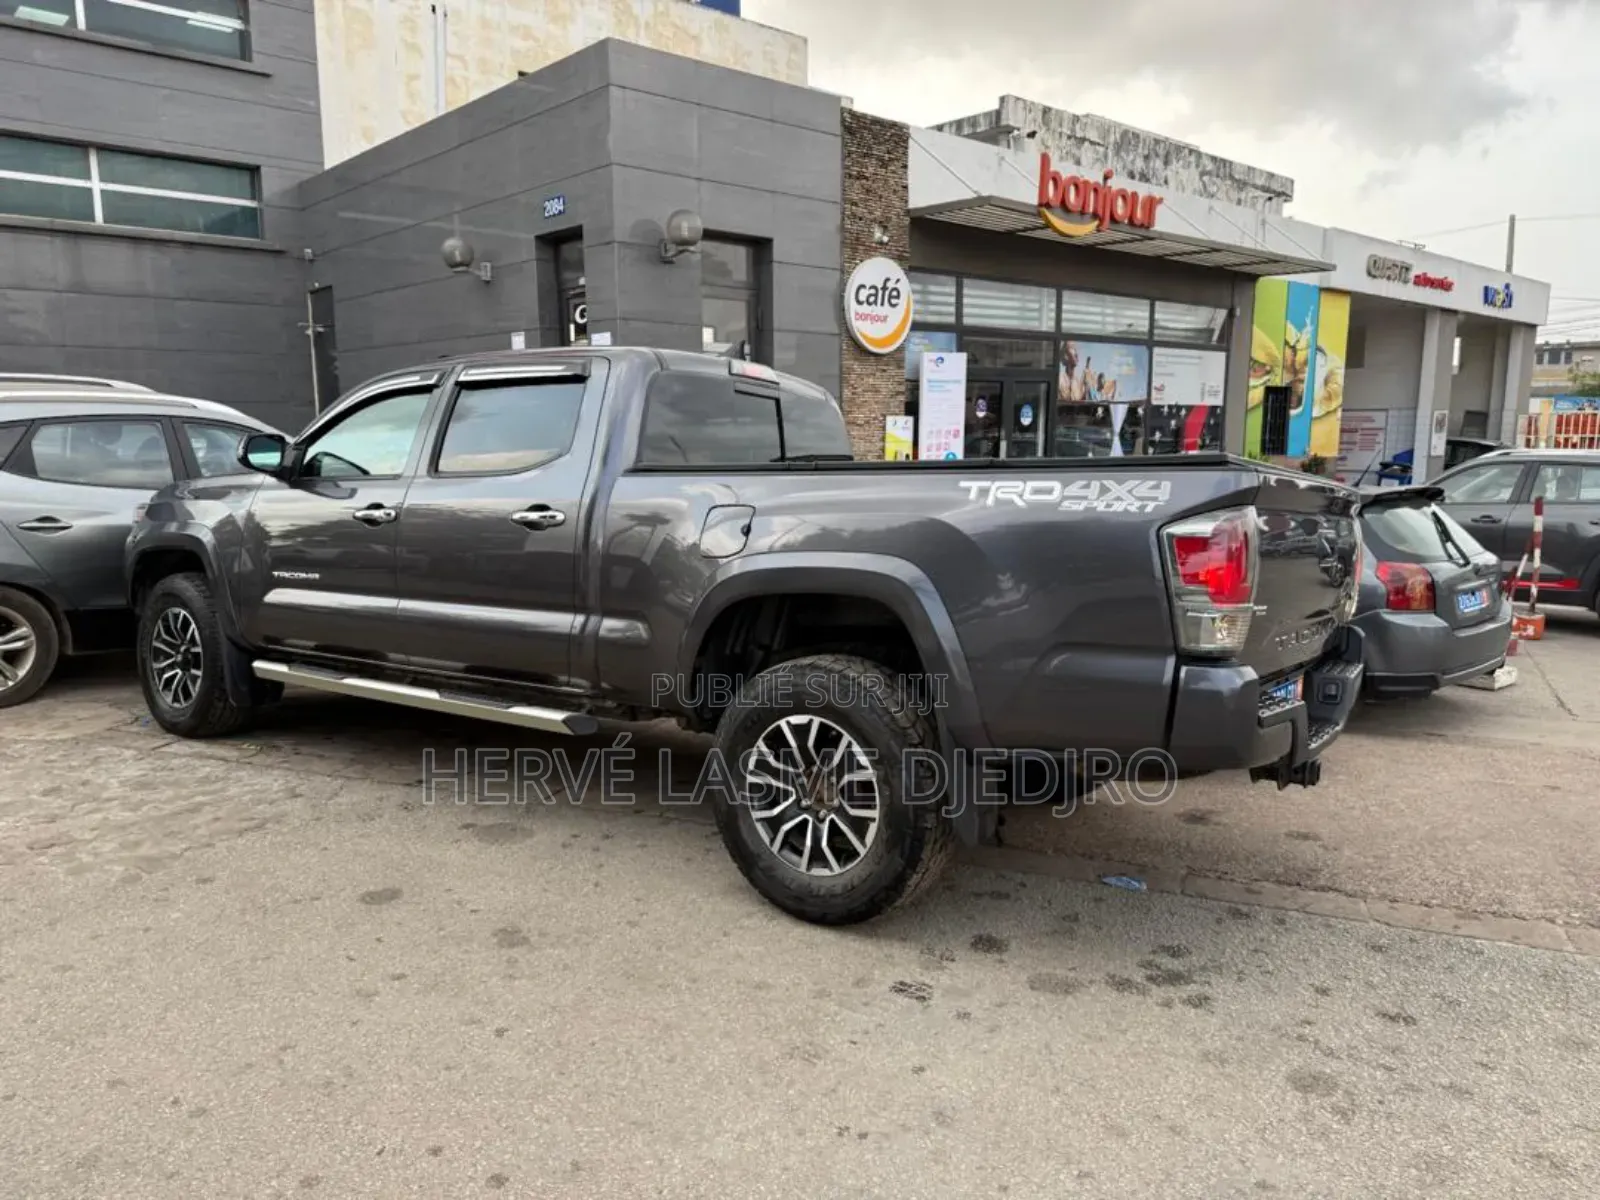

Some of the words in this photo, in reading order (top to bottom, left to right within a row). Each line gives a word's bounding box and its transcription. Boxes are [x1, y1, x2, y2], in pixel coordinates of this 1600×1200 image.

[1038, 152, 1164, 231] bonjour
[543, 196, 564, 217] 2084
[854, 276, 902, 308] café
[854, 309, 888, 324] bonjour
[957, 480, 1063, 508] TRD
[1062, 479, 1172, 502] 4X4
[1057, 500, 1166, 513] SPORT
